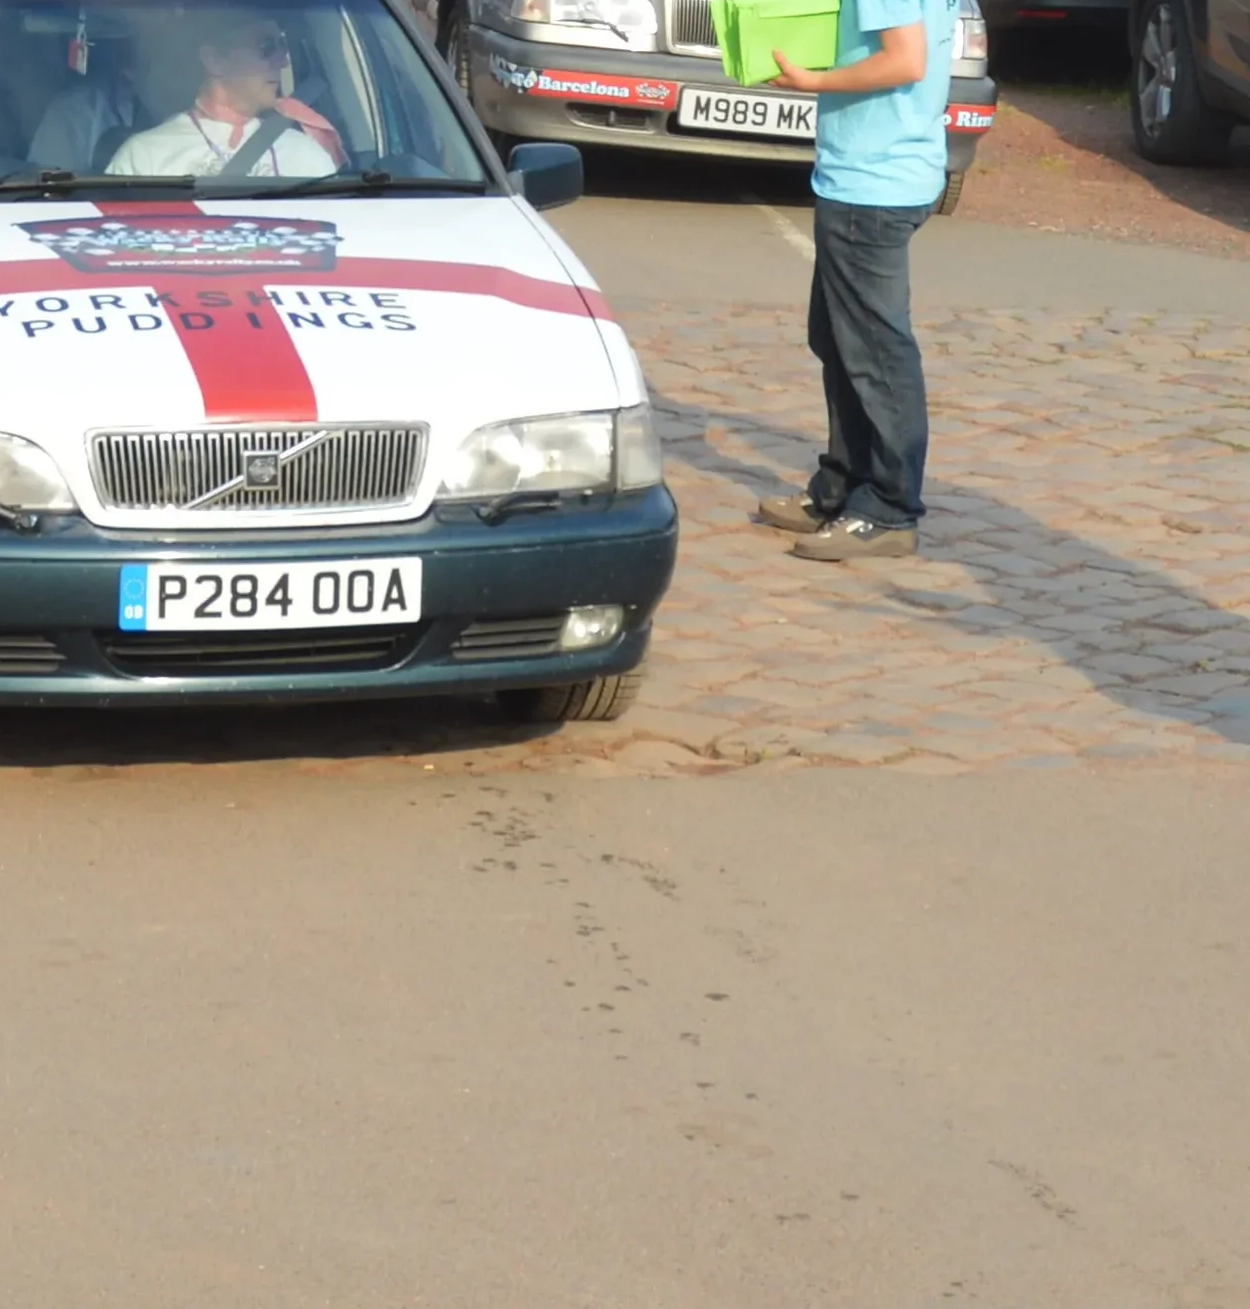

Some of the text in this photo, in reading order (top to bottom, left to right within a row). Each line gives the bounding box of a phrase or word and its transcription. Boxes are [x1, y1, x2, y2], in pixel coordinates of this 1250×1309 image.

[537, 74, 630, 98] Barcelona
[692, 95, 814, 132] M989 MK
[21, 311, 417, 339] PUDDINGS
[158, 573, 293, 619] P284
